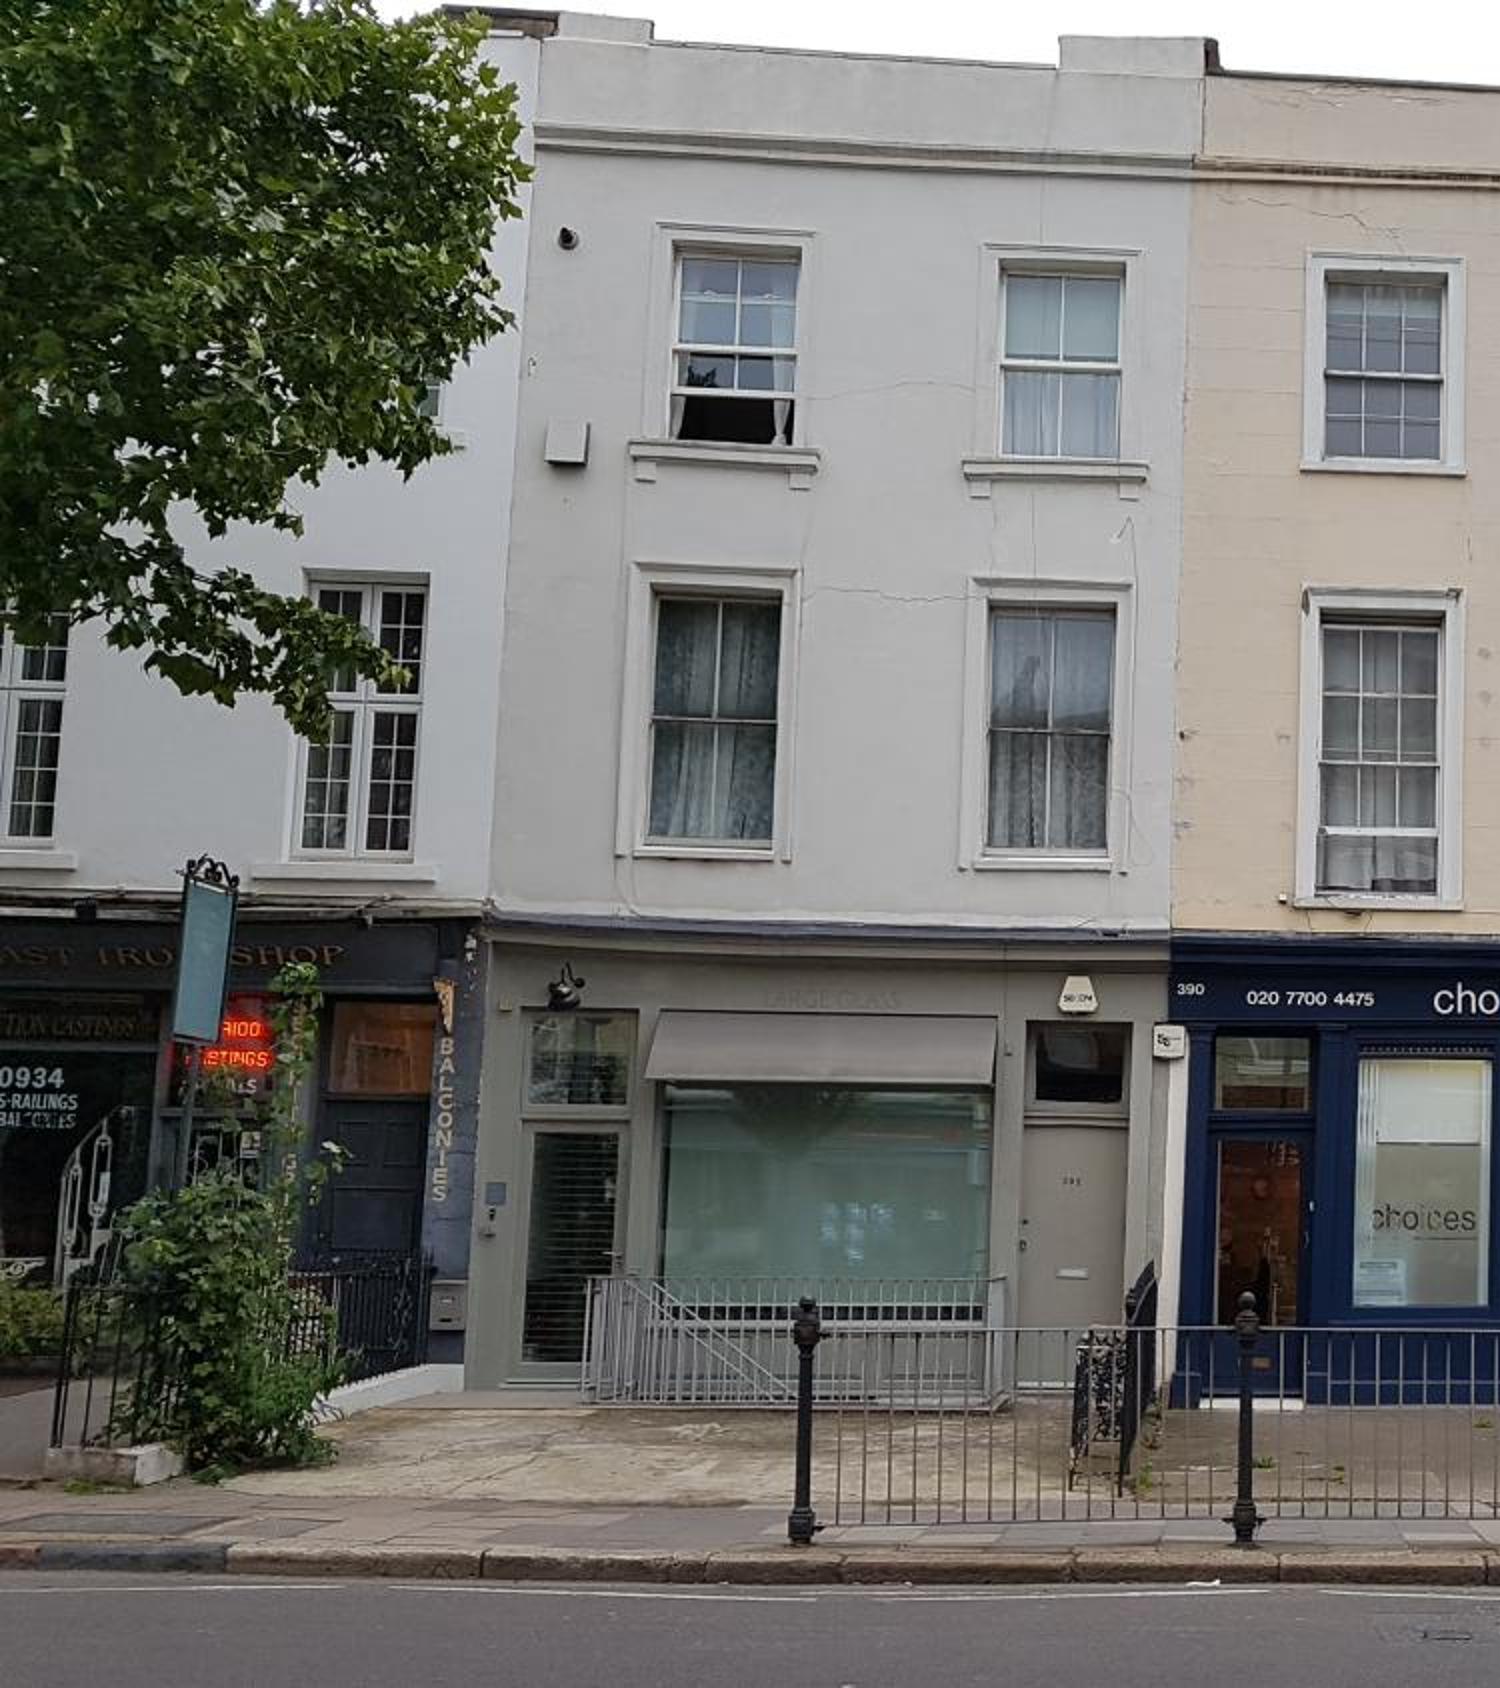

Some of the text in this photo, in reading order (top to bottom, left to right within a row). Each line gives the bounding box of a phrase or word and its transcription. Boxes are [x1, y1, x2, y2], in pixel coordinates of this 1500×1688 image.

[98, 946, 173, 967] IRO
[230, 945, 346, 967] SHOP
[1177, 983, 1205, 995] 390
[1246, 991, 1375, 1007] 020 7700 4475
[0, 1066, 65, 1088] 0934
[431, 1038, 456, 1202] BALCONIES
[1372, 1204, 1477, 1231] choices
